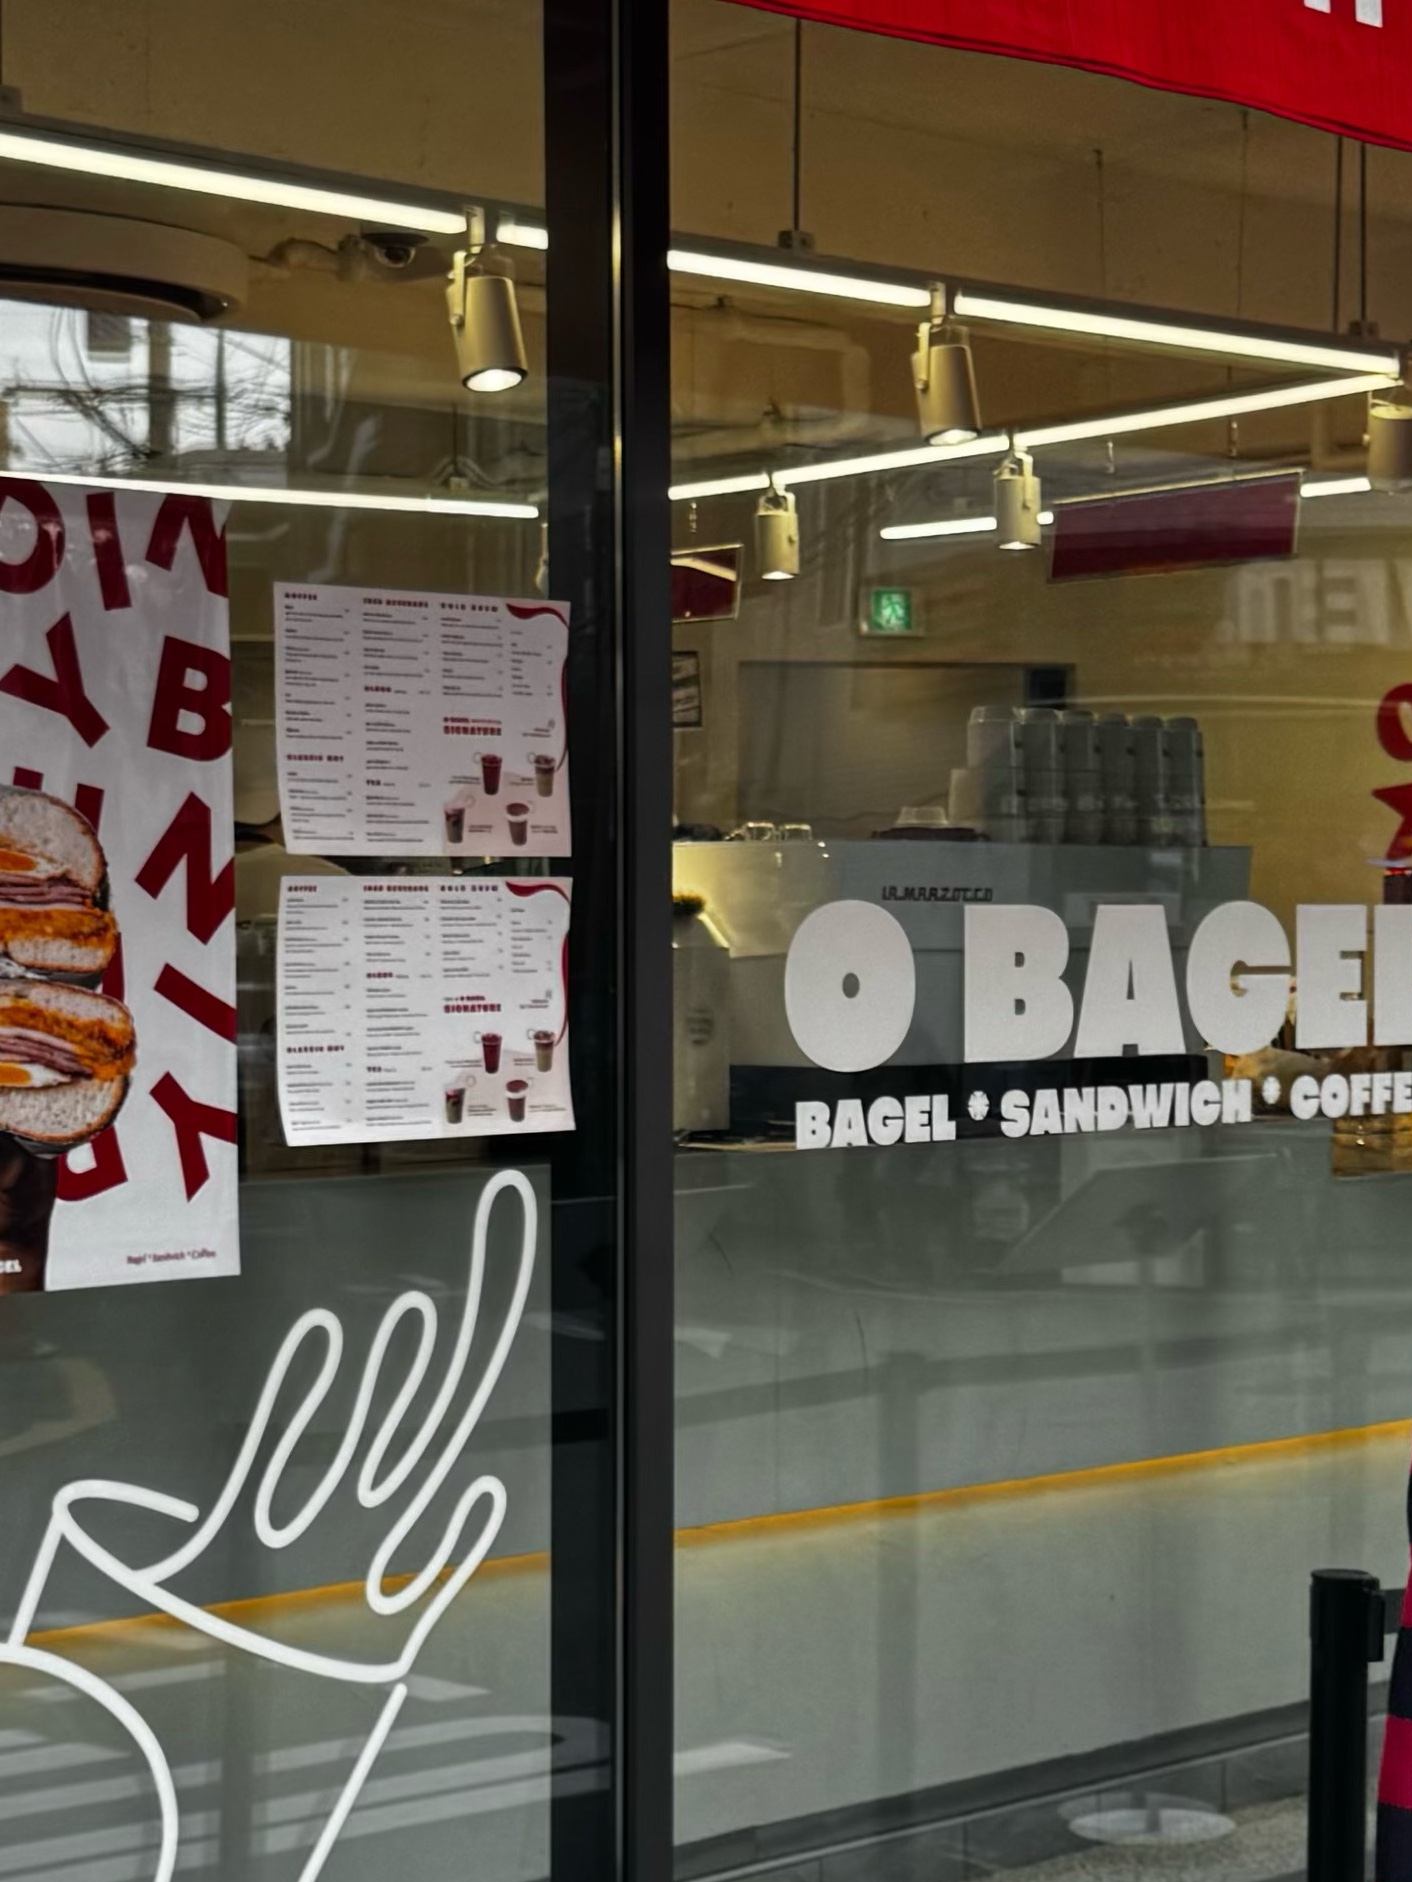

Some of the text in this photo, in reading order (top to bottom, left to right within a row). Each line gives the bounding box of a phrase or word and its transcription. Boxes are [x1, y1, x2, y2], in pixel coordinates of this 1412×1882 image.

[784, 901, 916, 1072] O
[795, 1094, 956, 1149] BAGEL
[1001, 1079, 1253, 1138] SANDWICH
